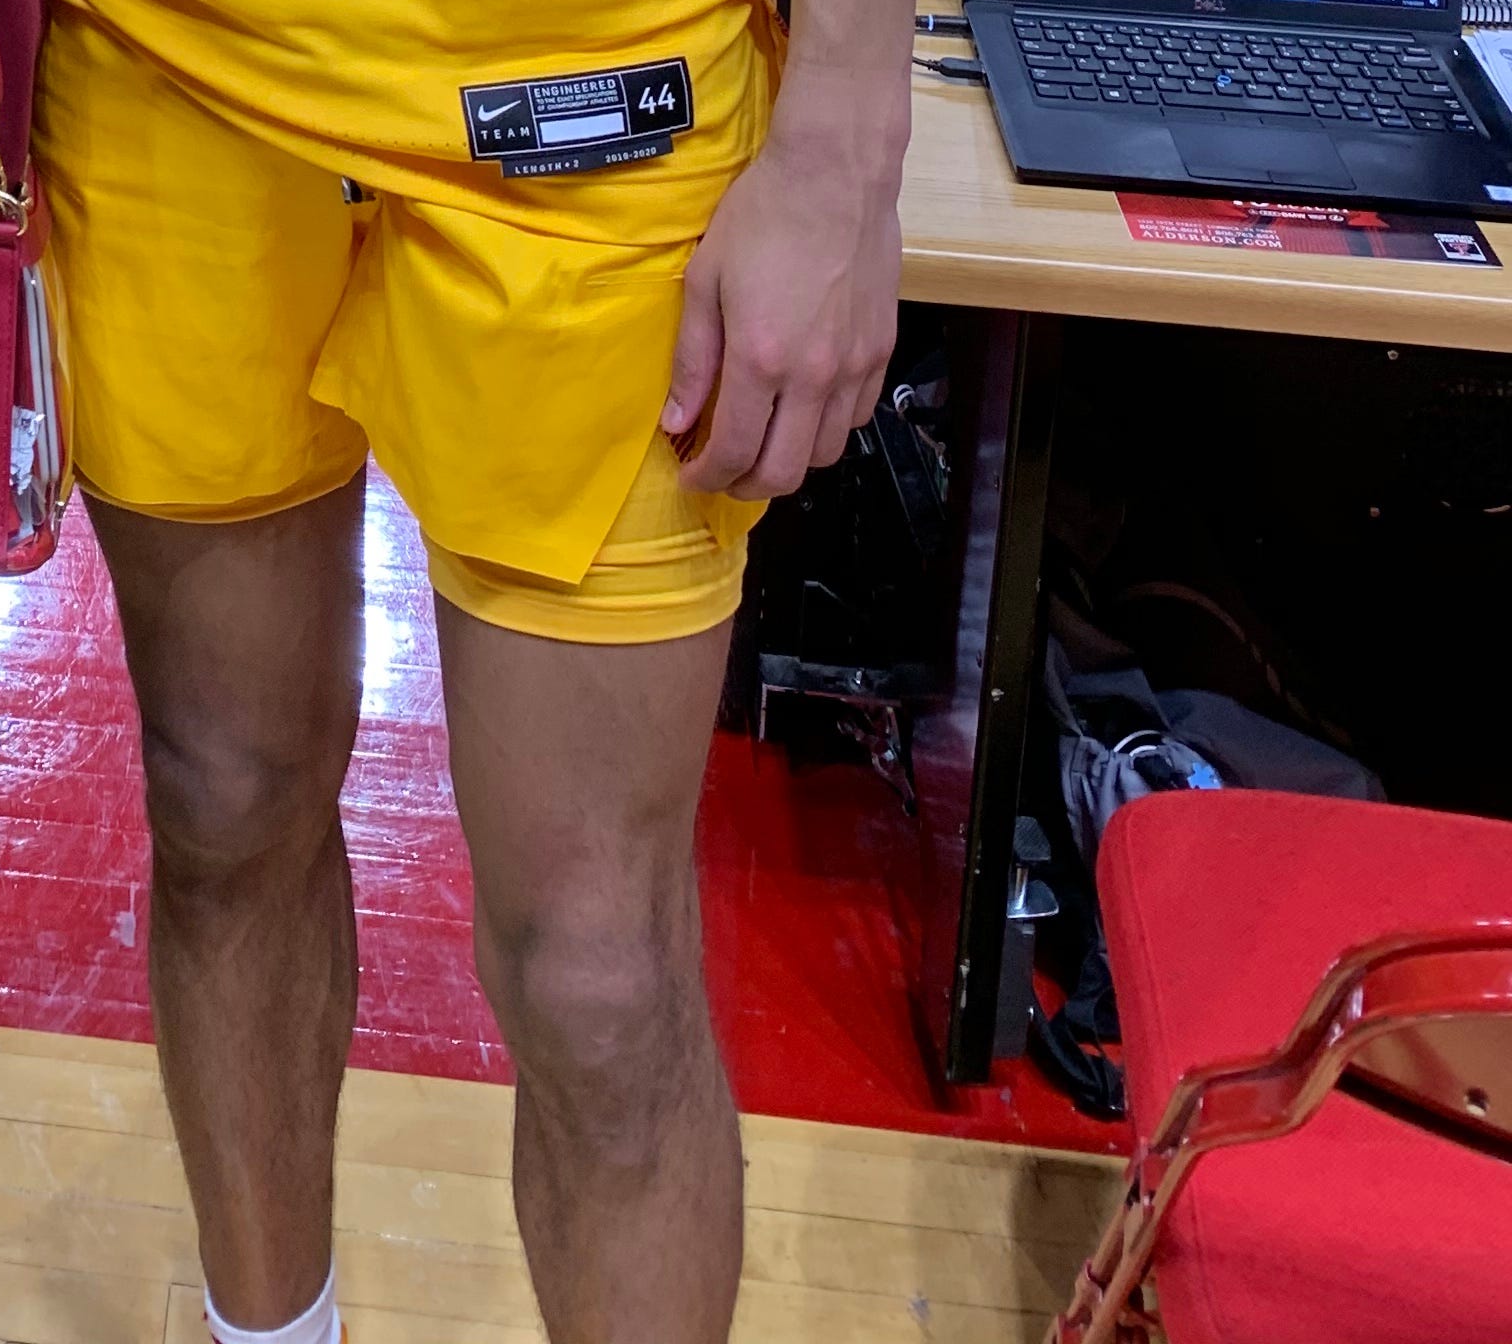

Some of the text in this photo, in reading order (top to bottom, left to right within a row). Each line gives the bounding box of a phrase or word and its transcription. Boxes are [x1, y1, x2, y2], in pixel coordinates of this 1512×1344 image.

[534, 78, 617, 98] ENGINEERED
[638, 83, 676, 115] 44
[480, 125, 531, 141] TEAM
[514, 162, 562, 175] LENGTH
[1141, 230, 1284, 249] ALDERSON.COM
